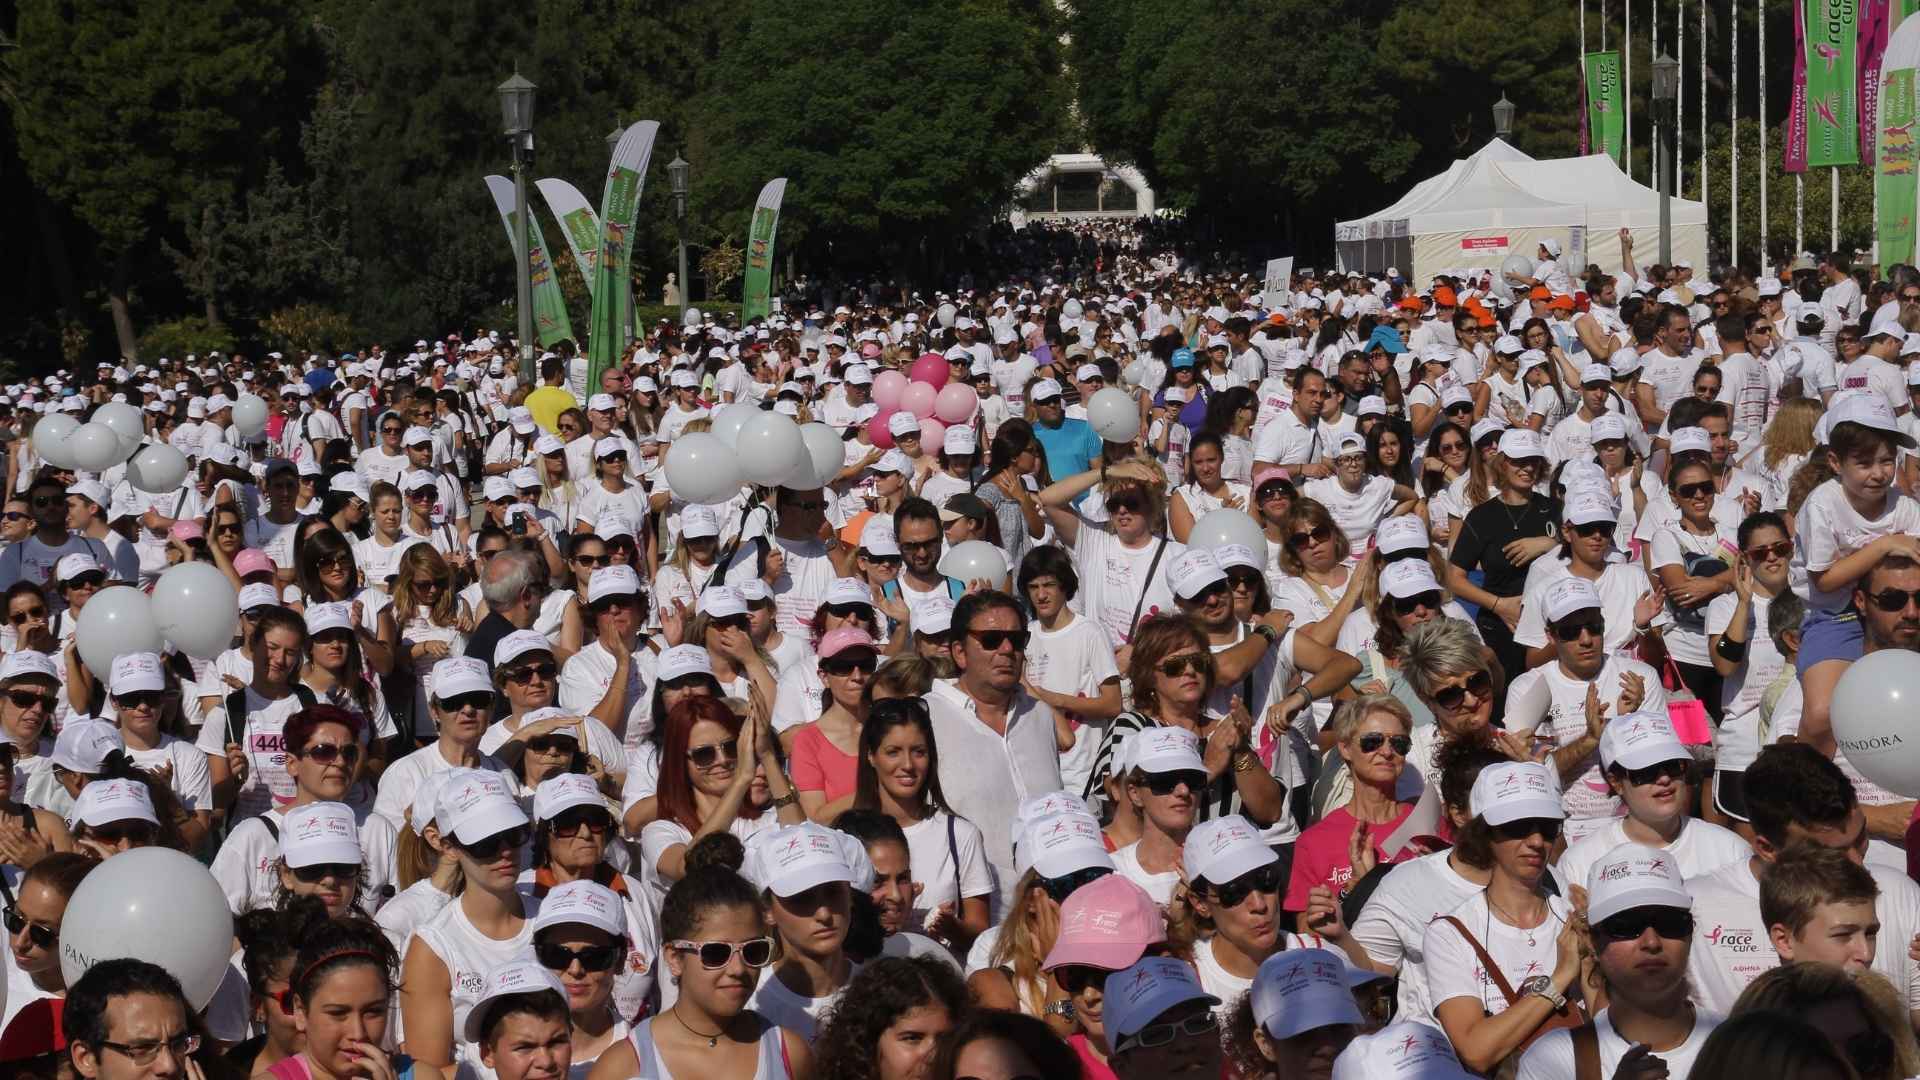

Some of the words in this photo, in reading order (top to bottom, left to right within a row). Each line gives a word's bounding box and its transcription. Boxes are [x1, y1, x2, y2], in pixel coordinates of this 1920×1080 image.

[1840, 734, 1903, 751] PANDORA
[1338, 871, 1352, 882] rac
[1720, 935, 1752, 945] race
[1733, 944, 1757, 952] cure
